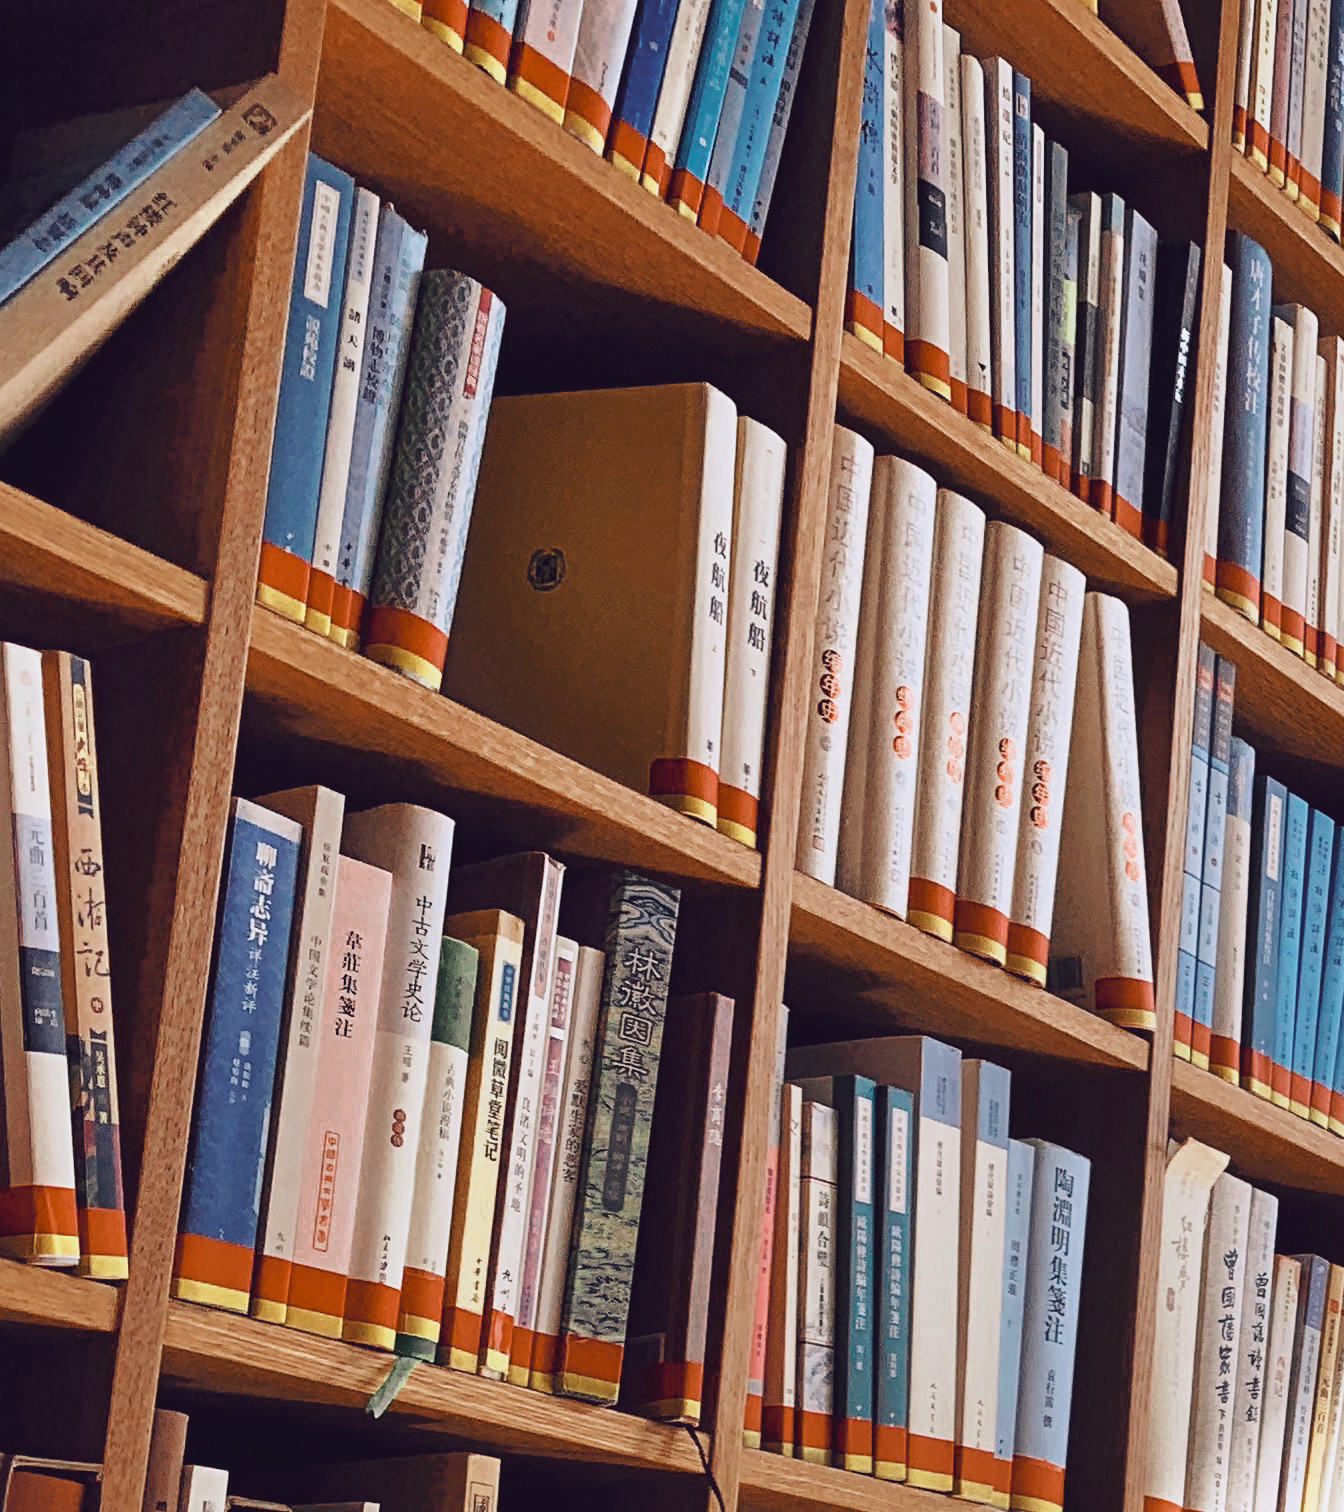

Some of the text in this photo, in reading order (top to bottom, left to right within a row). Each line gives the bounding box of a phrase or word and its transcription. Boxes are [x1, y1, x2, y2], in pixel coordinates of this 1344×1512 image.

[708, 531, 728, 626] 夜航船
[747, 560, 770, 652] 夜航船
[401, 895, 433, 1023] 中古文学史论
[611, 948, 662, 1078] 林徽因集
[485, 1038, 509, 1161] 阅微草堂笔记
[1044, 1167, 1075, 1345] 陶淵明集箋注
